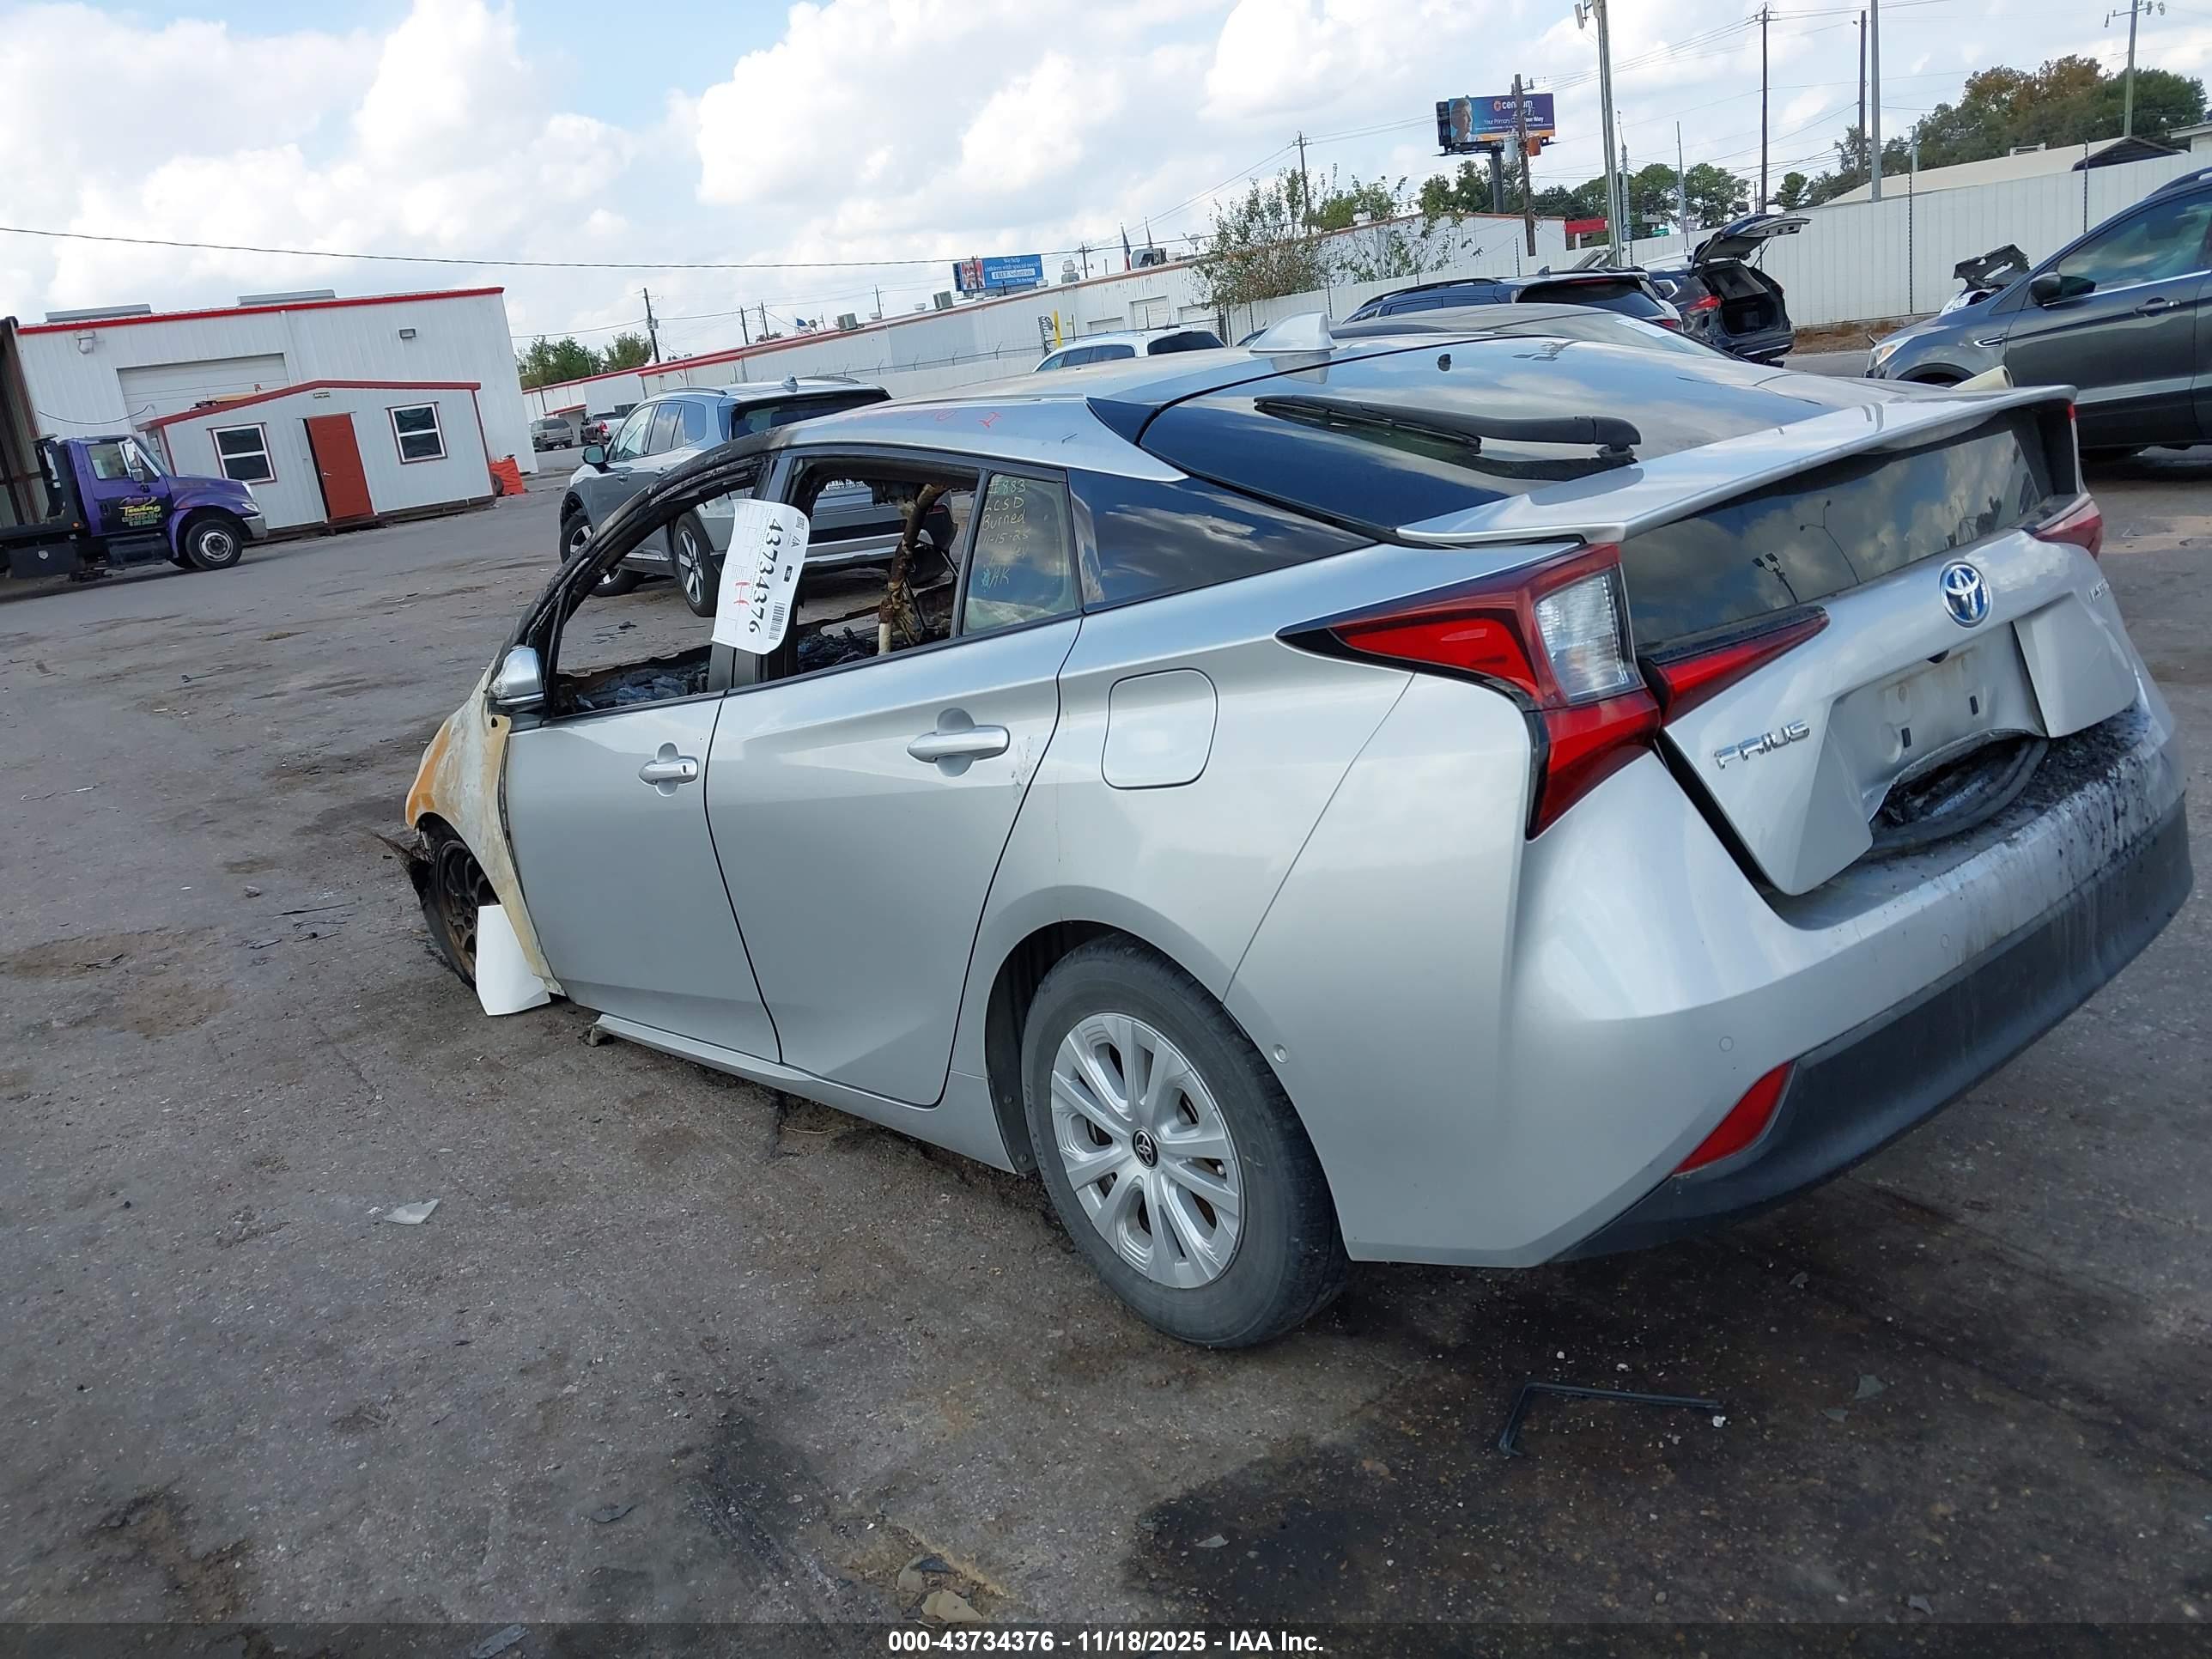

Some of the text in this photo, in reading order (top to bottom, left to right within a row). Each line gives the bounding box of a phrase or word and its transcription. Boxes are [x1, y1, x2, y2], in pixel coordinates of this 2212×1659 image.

[981, 508, 1026, 531] Burned
[749, 518, 783, 634] 43734376
[1712, 719, 1811, 770] PRIUS
